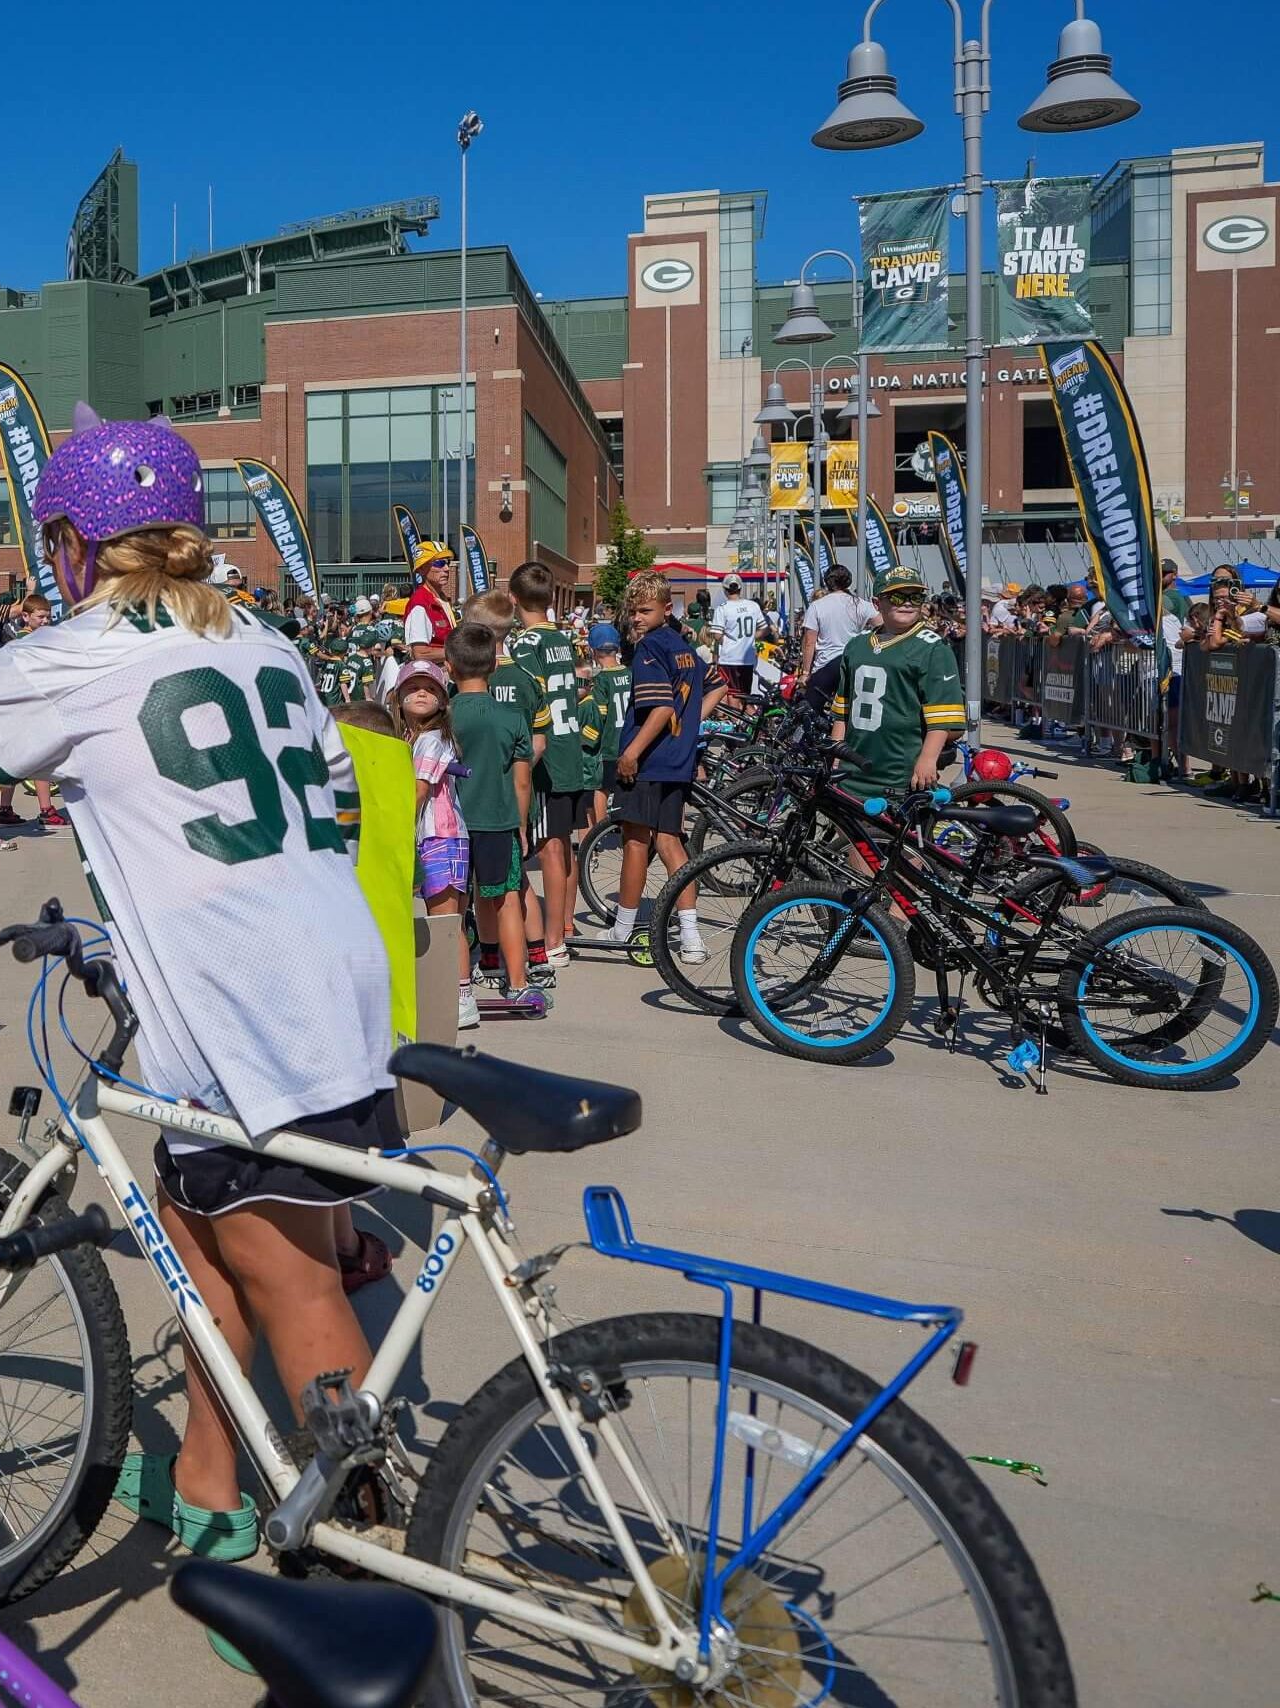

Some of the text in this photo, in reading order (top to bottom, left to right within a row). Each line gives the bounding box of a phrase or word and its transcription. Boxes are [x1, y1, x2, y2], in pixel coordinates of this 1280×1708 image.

[1014, 225, 1078, 251] IT ALL
[870, 250, 942, 270] TRAINING
[1003, 249, 1086, 276] STARTS
[871, 262, 941, 290] CAMP
[1016, 273, 1075, 299] HERE.
[828, 374, 901, 390] ONIDA
[997, 368, 1048, 382] GATE
[1056, 361, 1090, 390] DREAM
[1062, 374, 1085, 394] DRIVE
[774, 472, 804, 482] CAMP
[736, 615, 753, 639] 10
[321, 674, 334, 693] 10
[490, 685, 517, 702] OVE
[613, 676, 630, 686] LOVE
[1206, 673, 1239, 694] TRAINING
[851, 664, 887, 732] 8
[1206, 691, 1237, 725] CAMP
[137, 665, 349, 866] 92
[123, 1181, 203, 1316] TREK
[416, 1233, 454, 1292] 800
